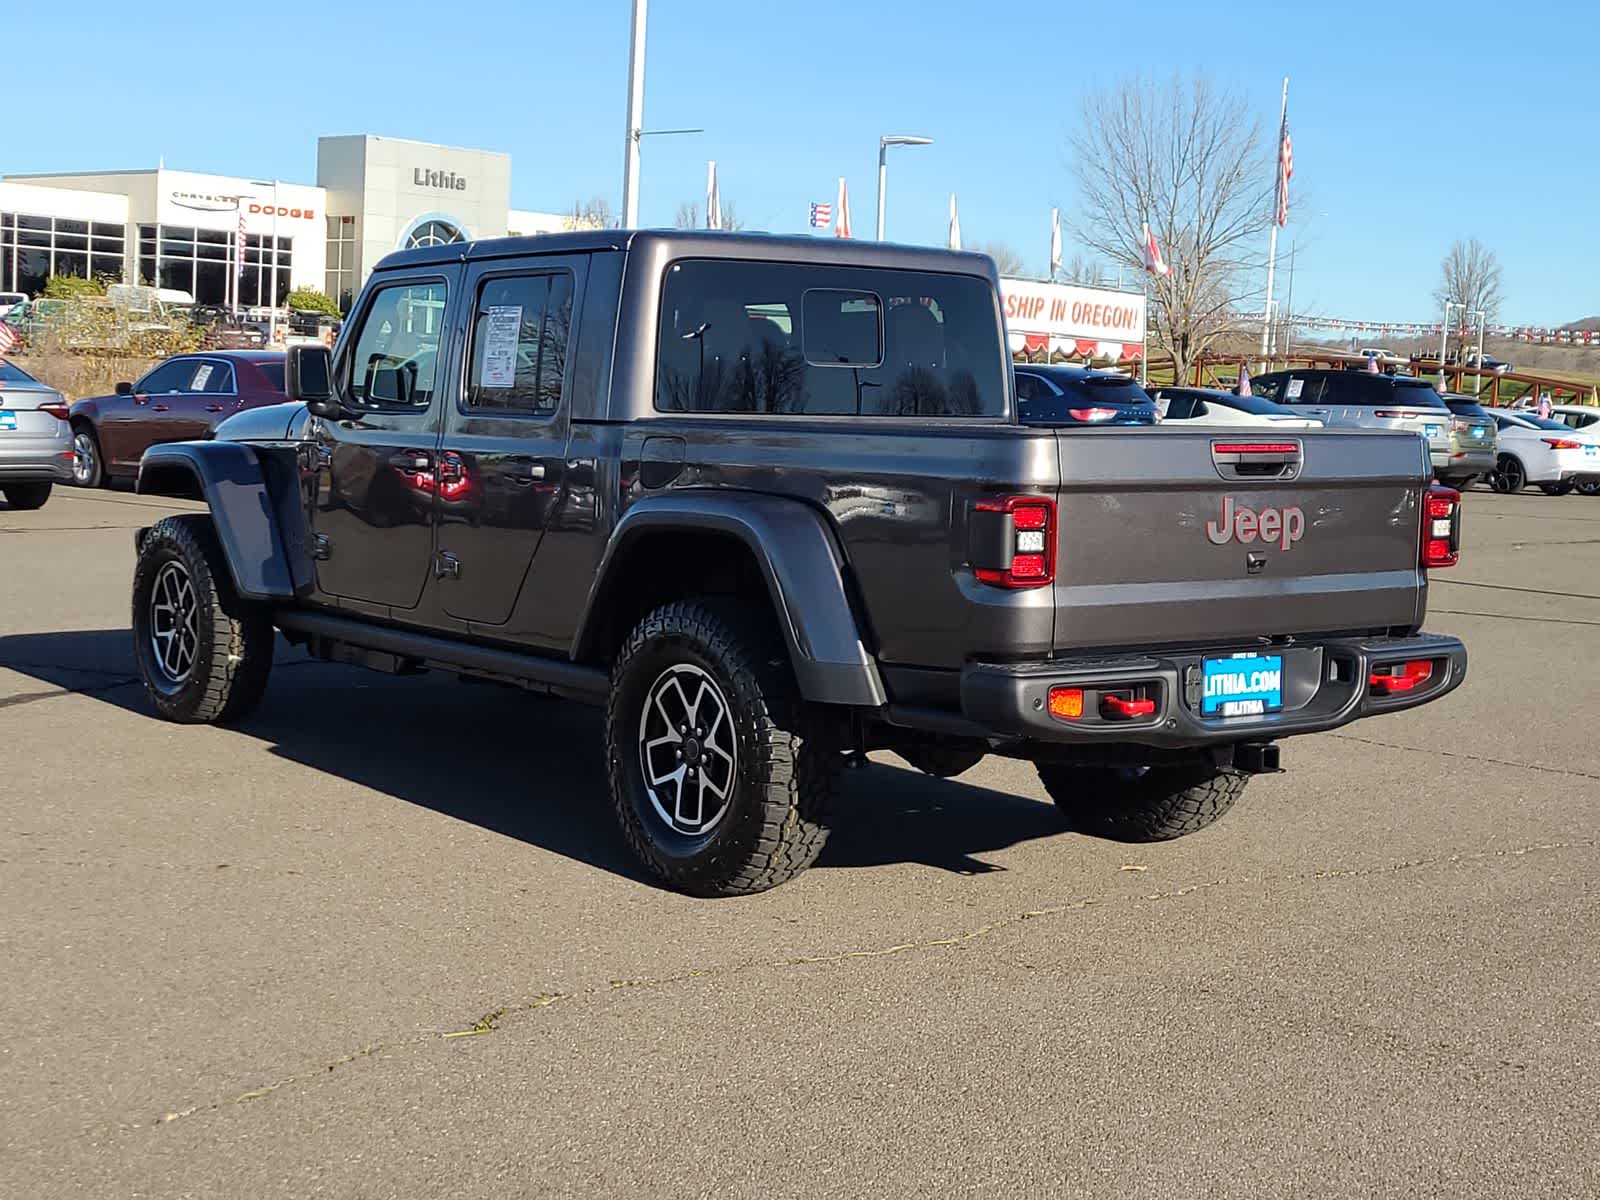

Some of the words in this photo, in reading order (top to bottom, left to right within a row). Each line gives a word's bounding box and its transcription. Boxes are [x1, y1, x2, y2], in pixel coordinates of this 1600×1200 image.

[414, 167, 466, 191] Lithia
[249, 203, 314, 219] DODGE
[1003, 294, 1045, 320] SHIP
[1049, 298, 1067, 322] IN
[1071, 301, 1138, 329] OREGON!
[1205, 496, 1305, 551] Jeep
[1203, 669, 1281, 698] LITHIA.COM
